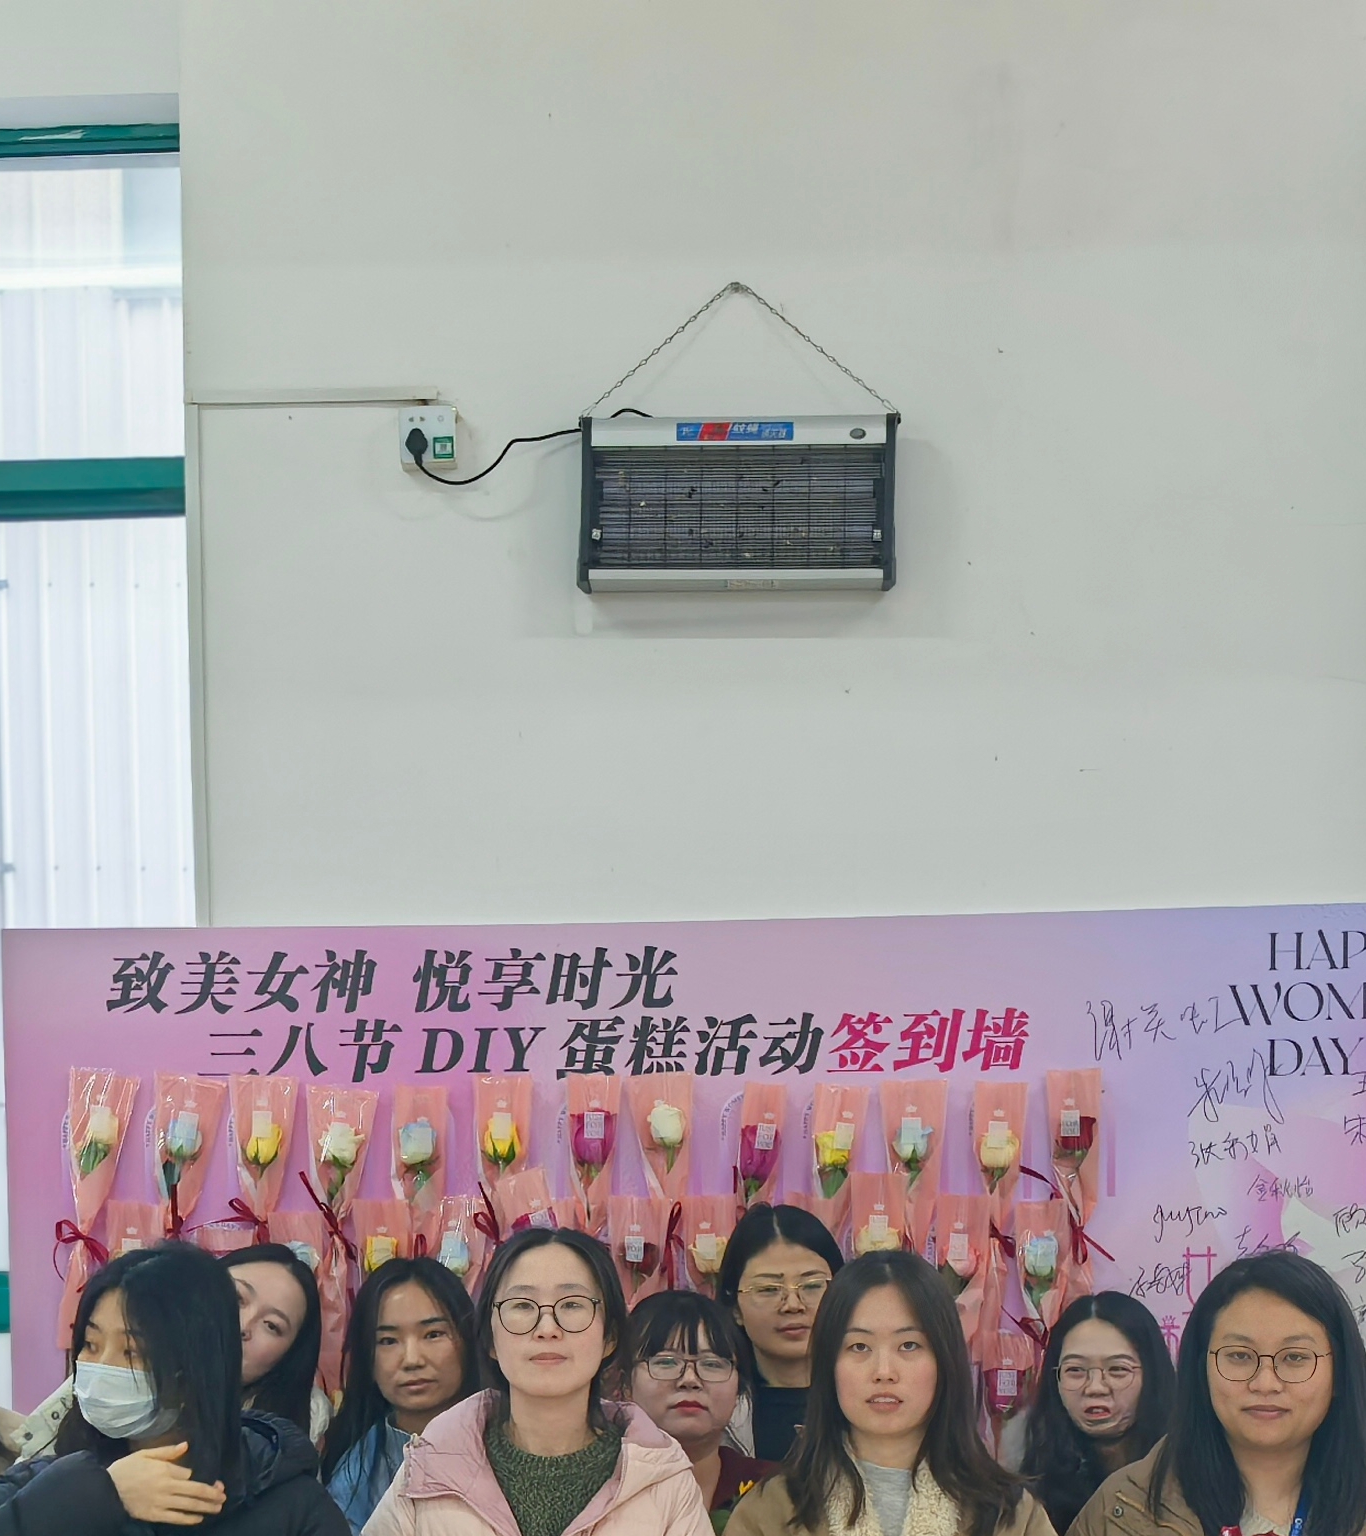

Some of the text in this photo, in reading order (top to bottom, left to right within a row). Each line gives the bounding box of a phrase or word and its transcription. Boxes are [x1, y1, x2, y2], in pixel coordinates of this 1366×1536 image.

[107, 945, 679, 1015] 致美女神 悦享时光
[197, 1006, 1029, 1083] 三八节 DIY 蛋糕活动签到墙
[1268, 1036, 1364, 1077] DAY
